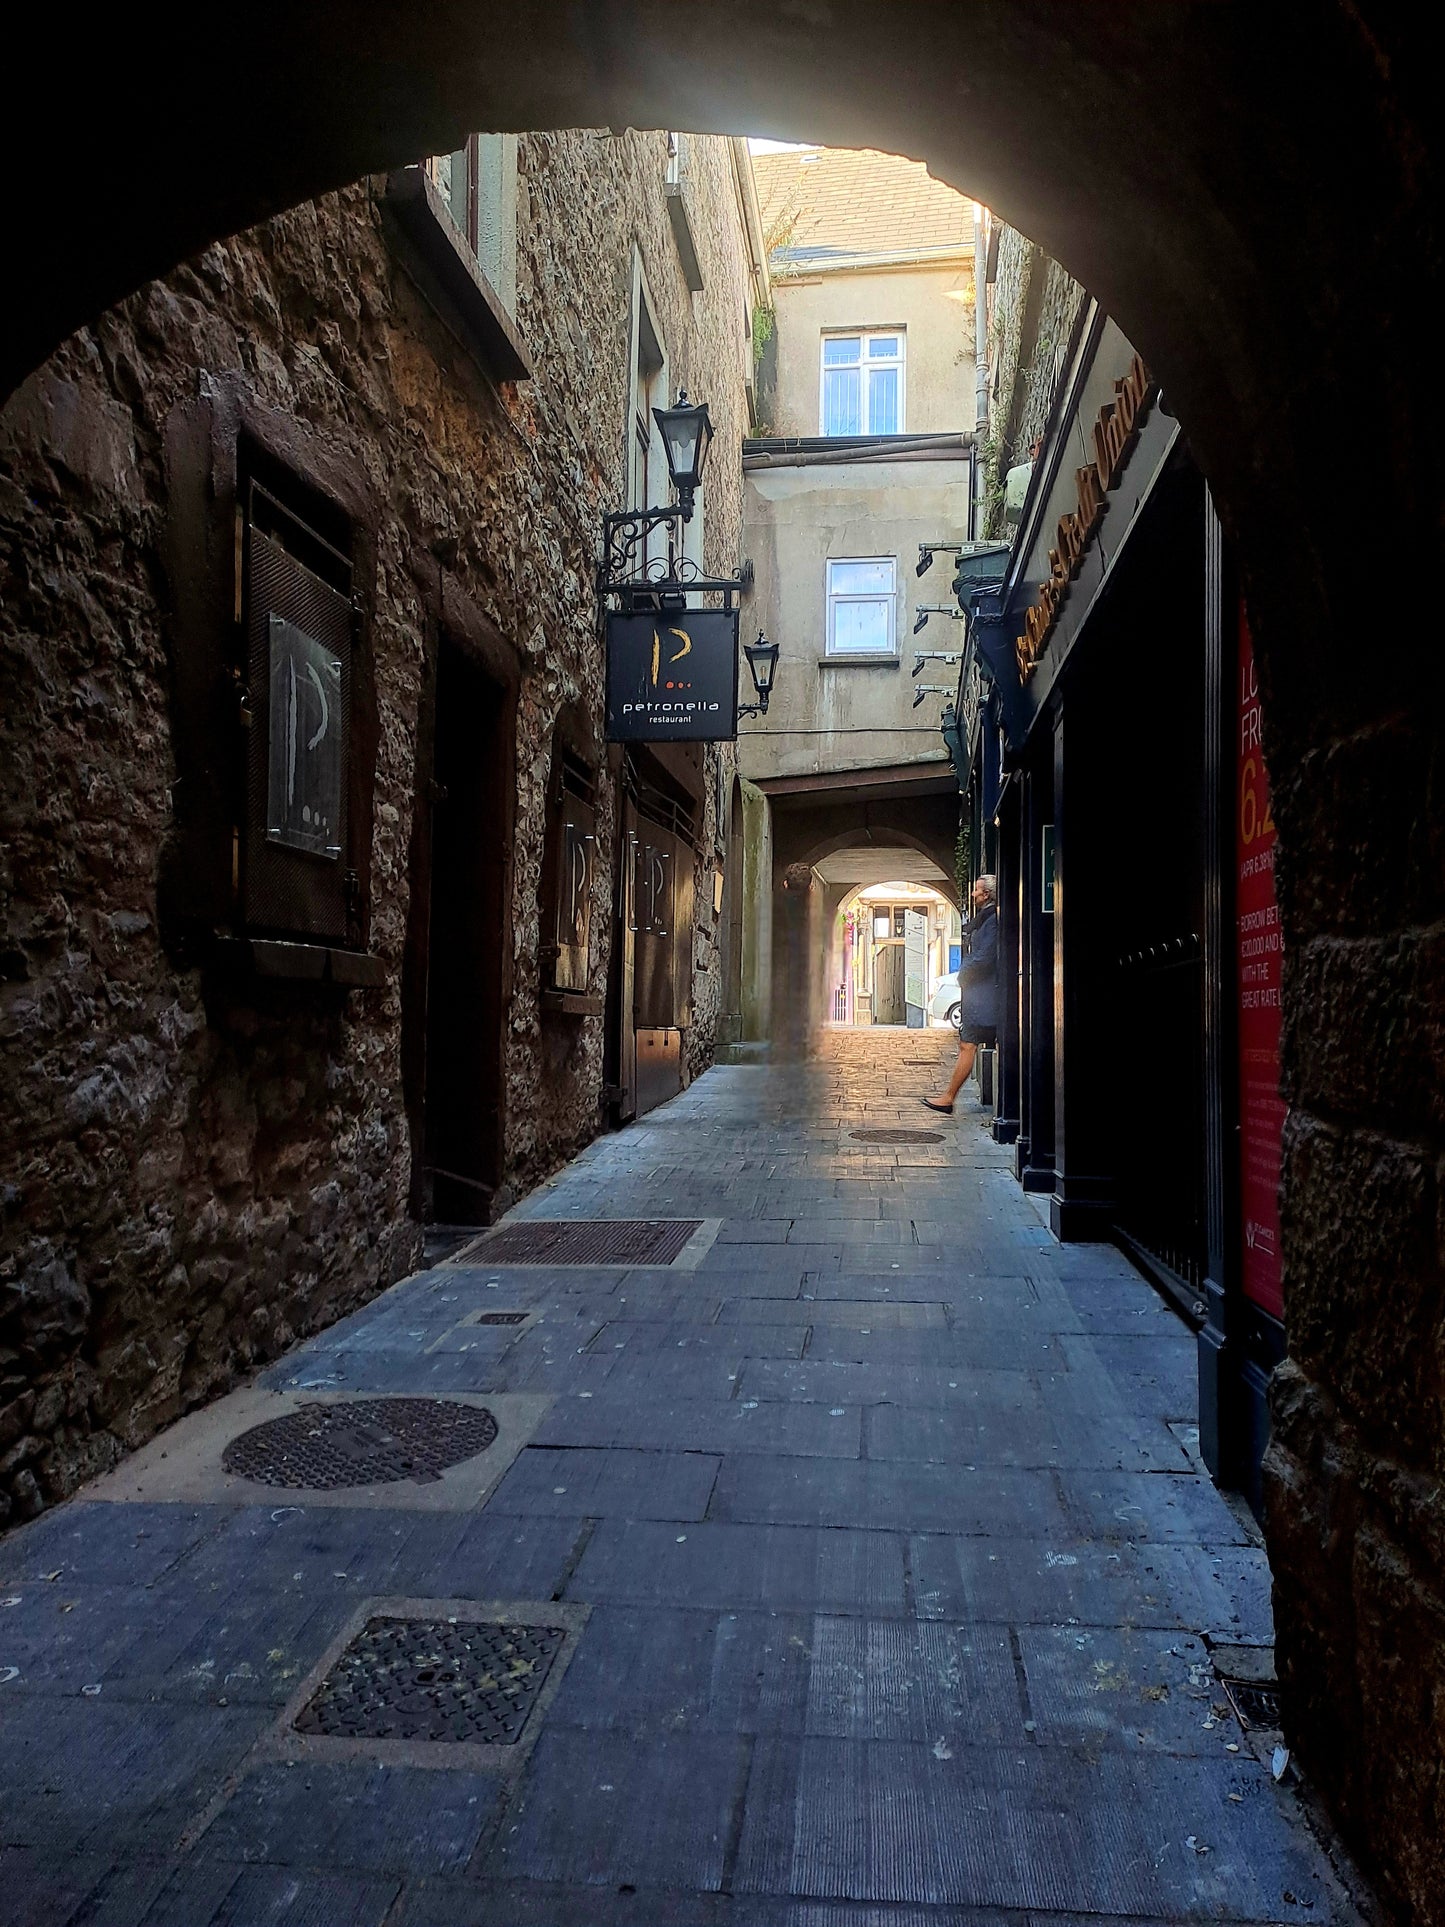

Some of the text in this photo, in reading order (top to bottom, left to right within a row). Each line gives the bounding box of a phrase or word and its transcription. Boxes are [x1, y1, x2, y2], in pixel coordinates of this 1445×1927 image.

[1092, 352, 1149, 492] Union
[621, 700, 721, 715] petronella
[648, 714, 693, 724] restaurant
[1240, 908, 1266, 933] BORROW
[1265, 932, 1279, 953] AND
[1241, 961, 1269, 984] WITH THE
[1241, 989, 1260, 1008] GREAT
[1260, 987, 1277, 1007] RATE
